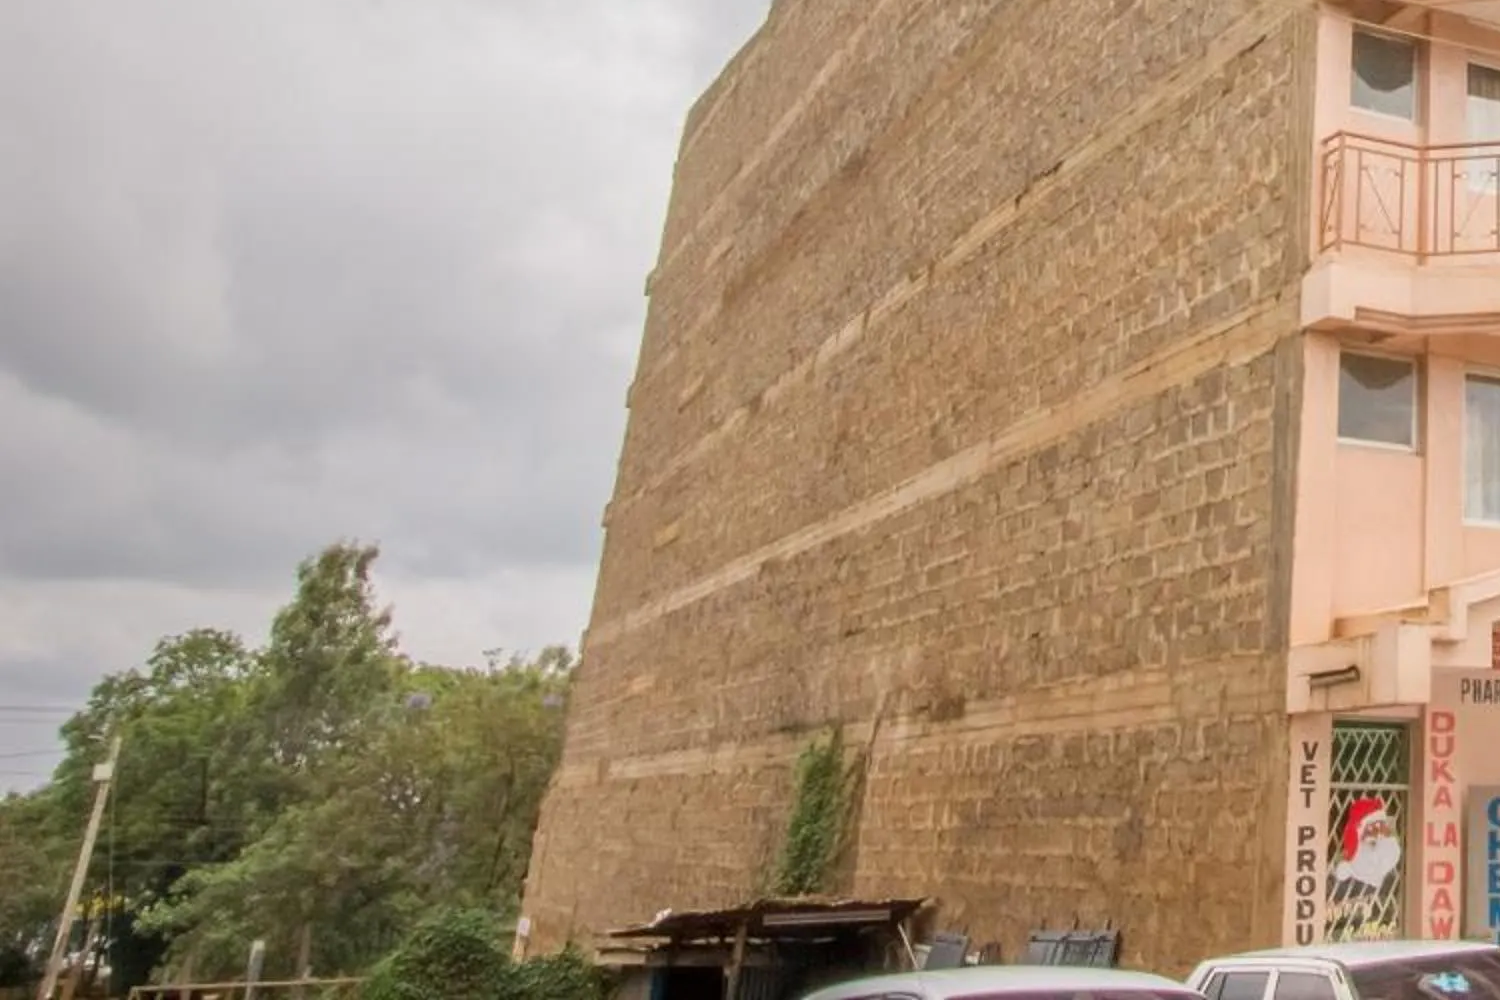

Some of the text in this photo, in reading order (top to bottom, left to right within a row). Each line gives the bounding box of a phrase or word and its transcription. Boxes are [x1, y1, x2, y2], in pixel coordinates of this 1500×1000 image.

[1300, 741, 1318, 808] VET
[1430, 711, 1456, 808] DUKA
[1426, 822, 1458, 847] LA
